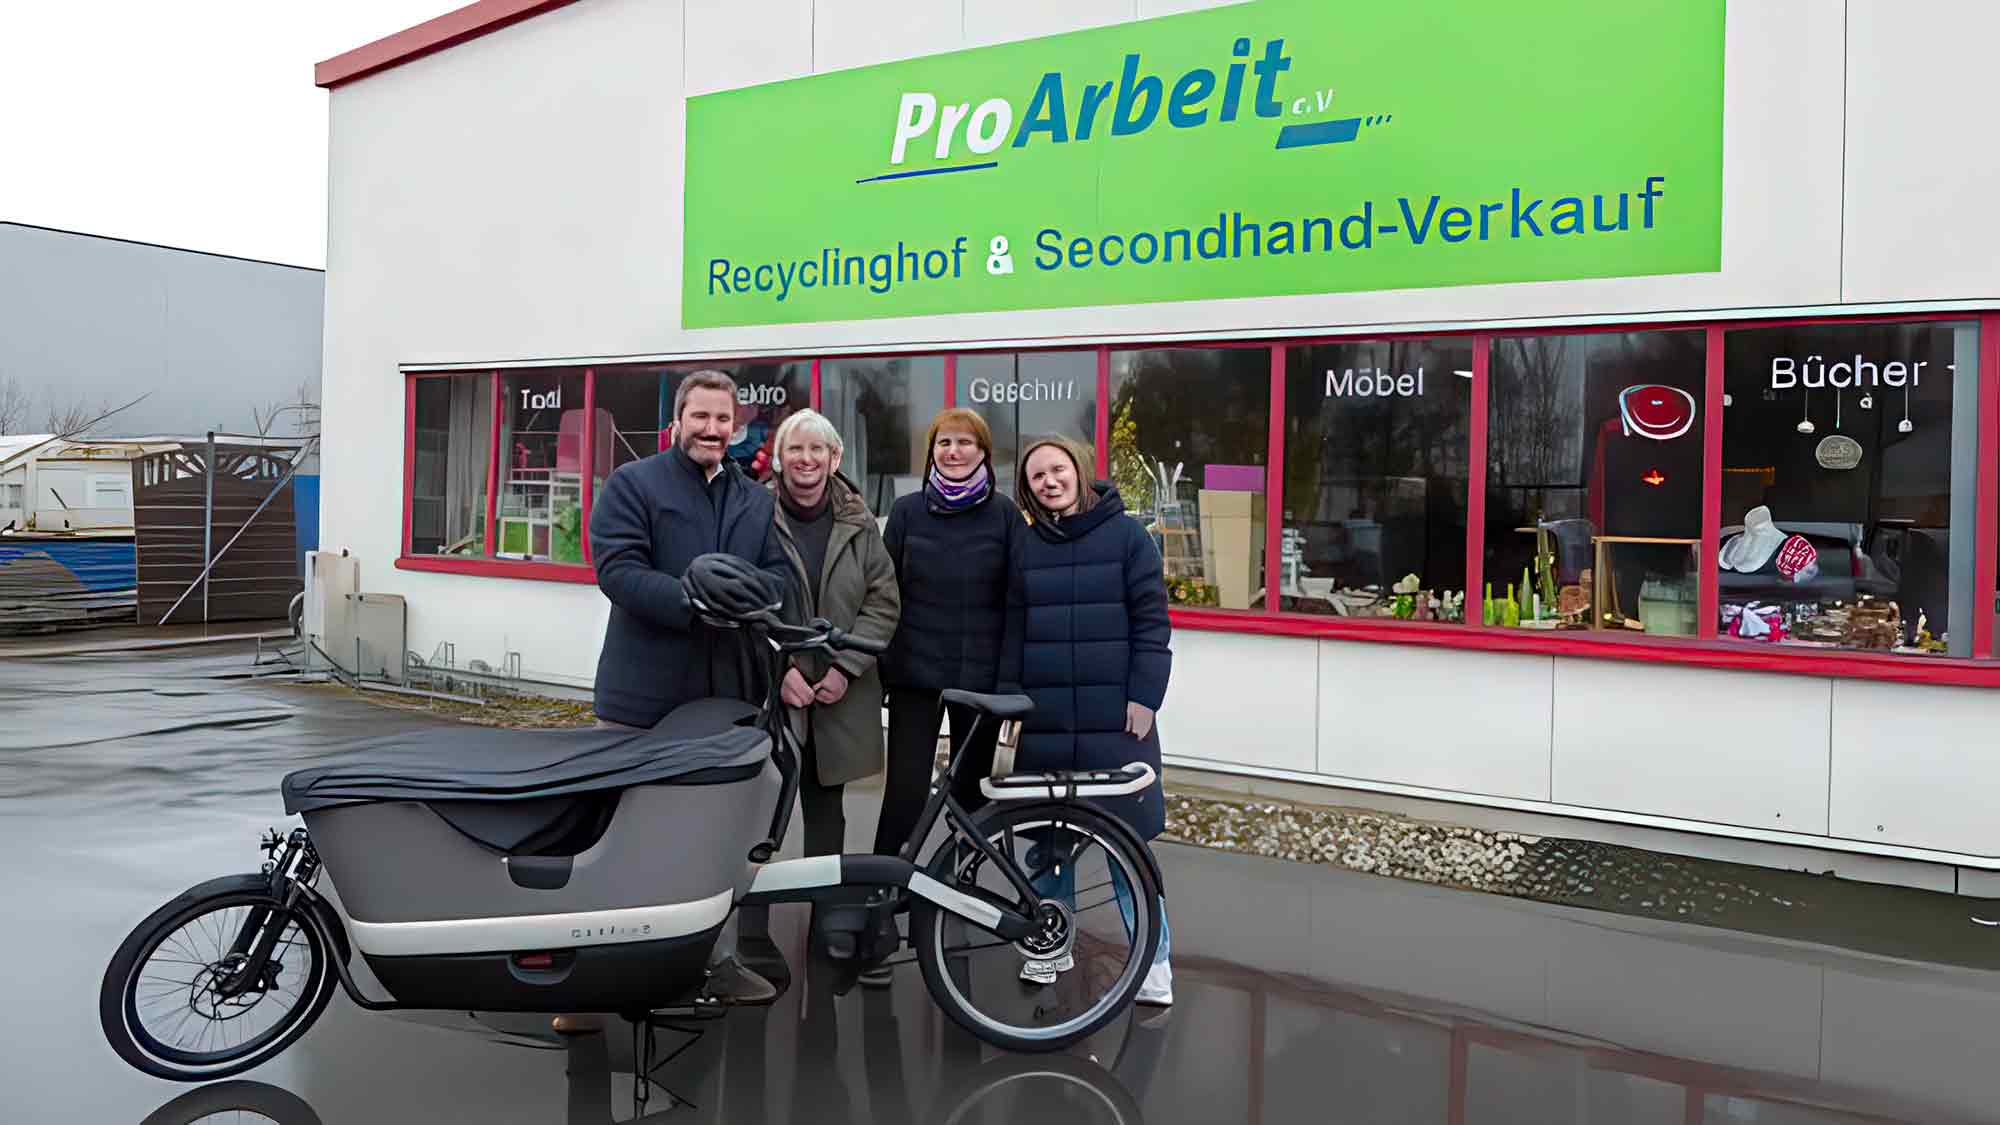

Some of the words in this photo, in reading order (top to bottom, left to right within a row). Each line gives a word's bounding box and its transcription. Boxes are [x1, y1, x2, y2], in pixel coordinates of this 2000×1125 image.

[707, 235, 968, 302] Recyclinghof
[985, 234, 1014, 275] &
[1033, 176, 1665, 272] Secondhand-Verkauf
[1325, 367, 1424, 397] Möbel
[1771, 354, 1928, 389] Bücher
